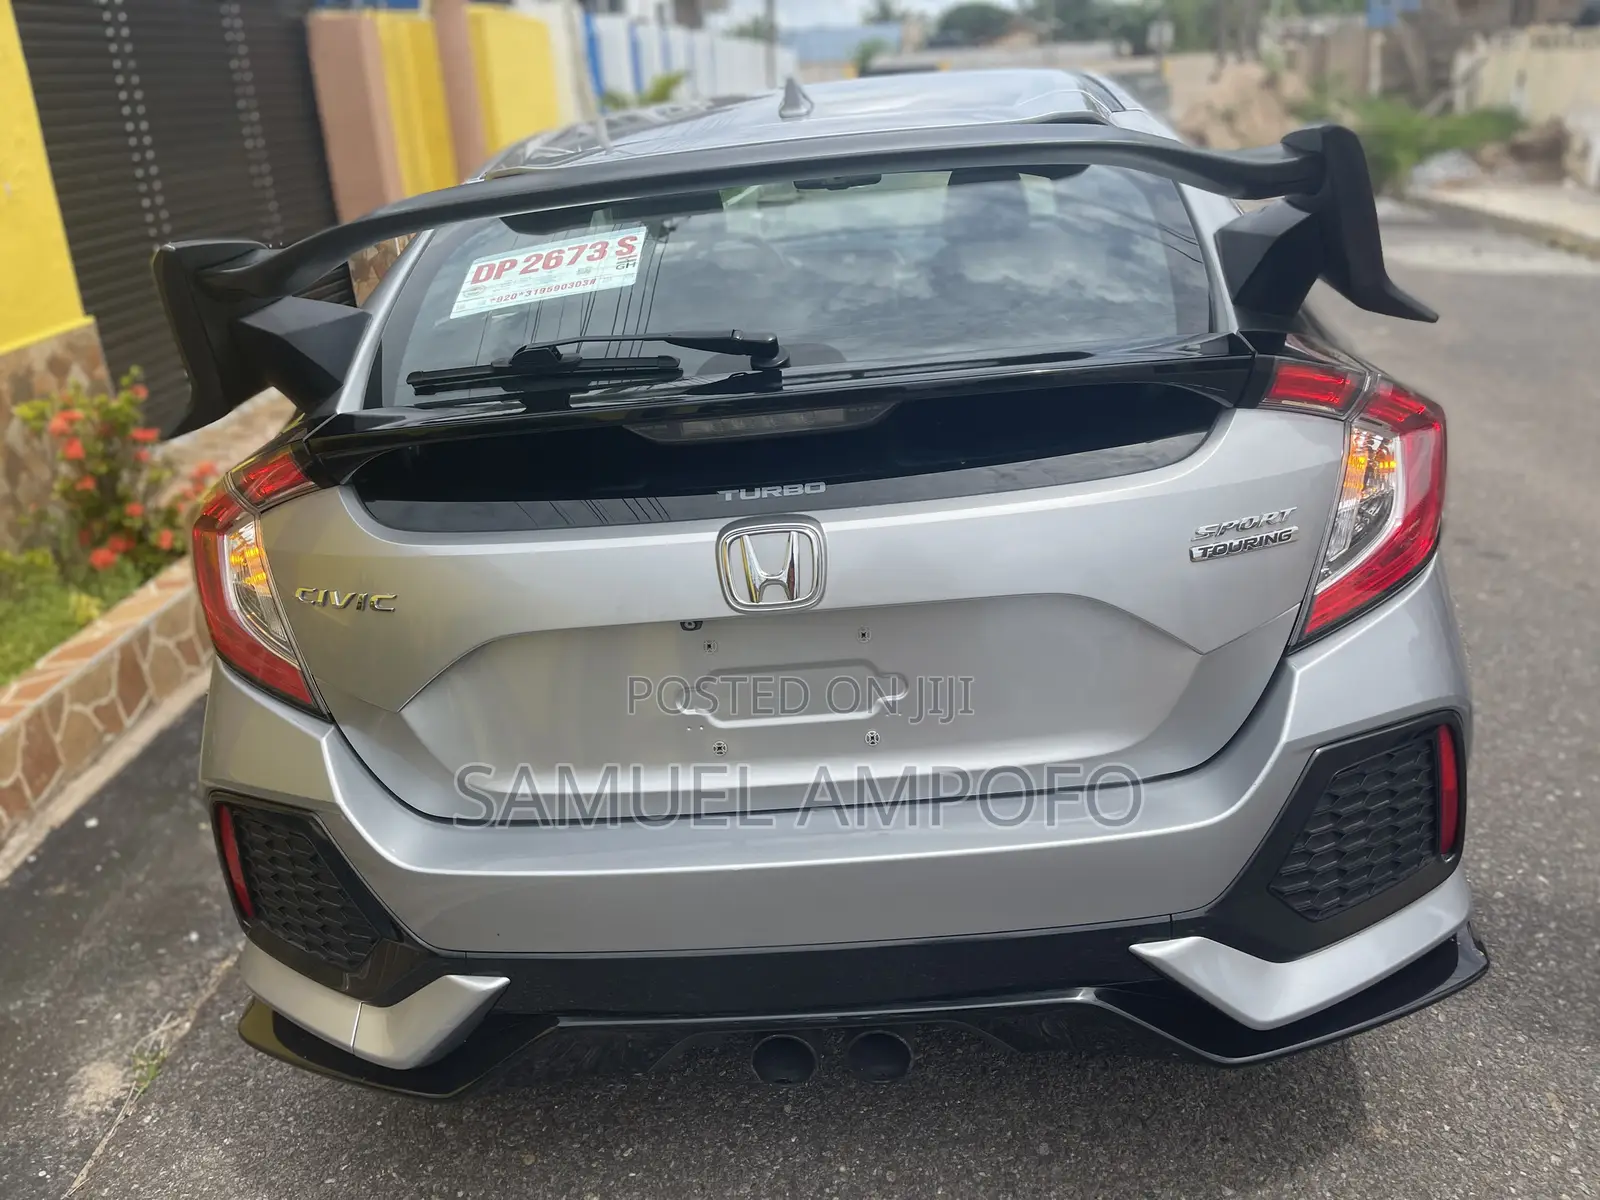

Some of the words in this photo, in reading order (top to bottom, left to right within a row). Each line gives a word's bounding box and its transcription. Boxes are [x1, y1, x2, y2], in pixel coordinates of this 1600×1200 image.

[471, 258, 518, 285] DP
[519, 241, 610, 275] 2673
[615, 235, 638, 256] S
[615, 261, 637, 270] GH
[716, 481, 828, 501] TURBO
[1190, 506, 1298, 542] SPORT
[1197, 528, 1293, 558] TOURING
[295, 587, 398, 612] CIVIC
